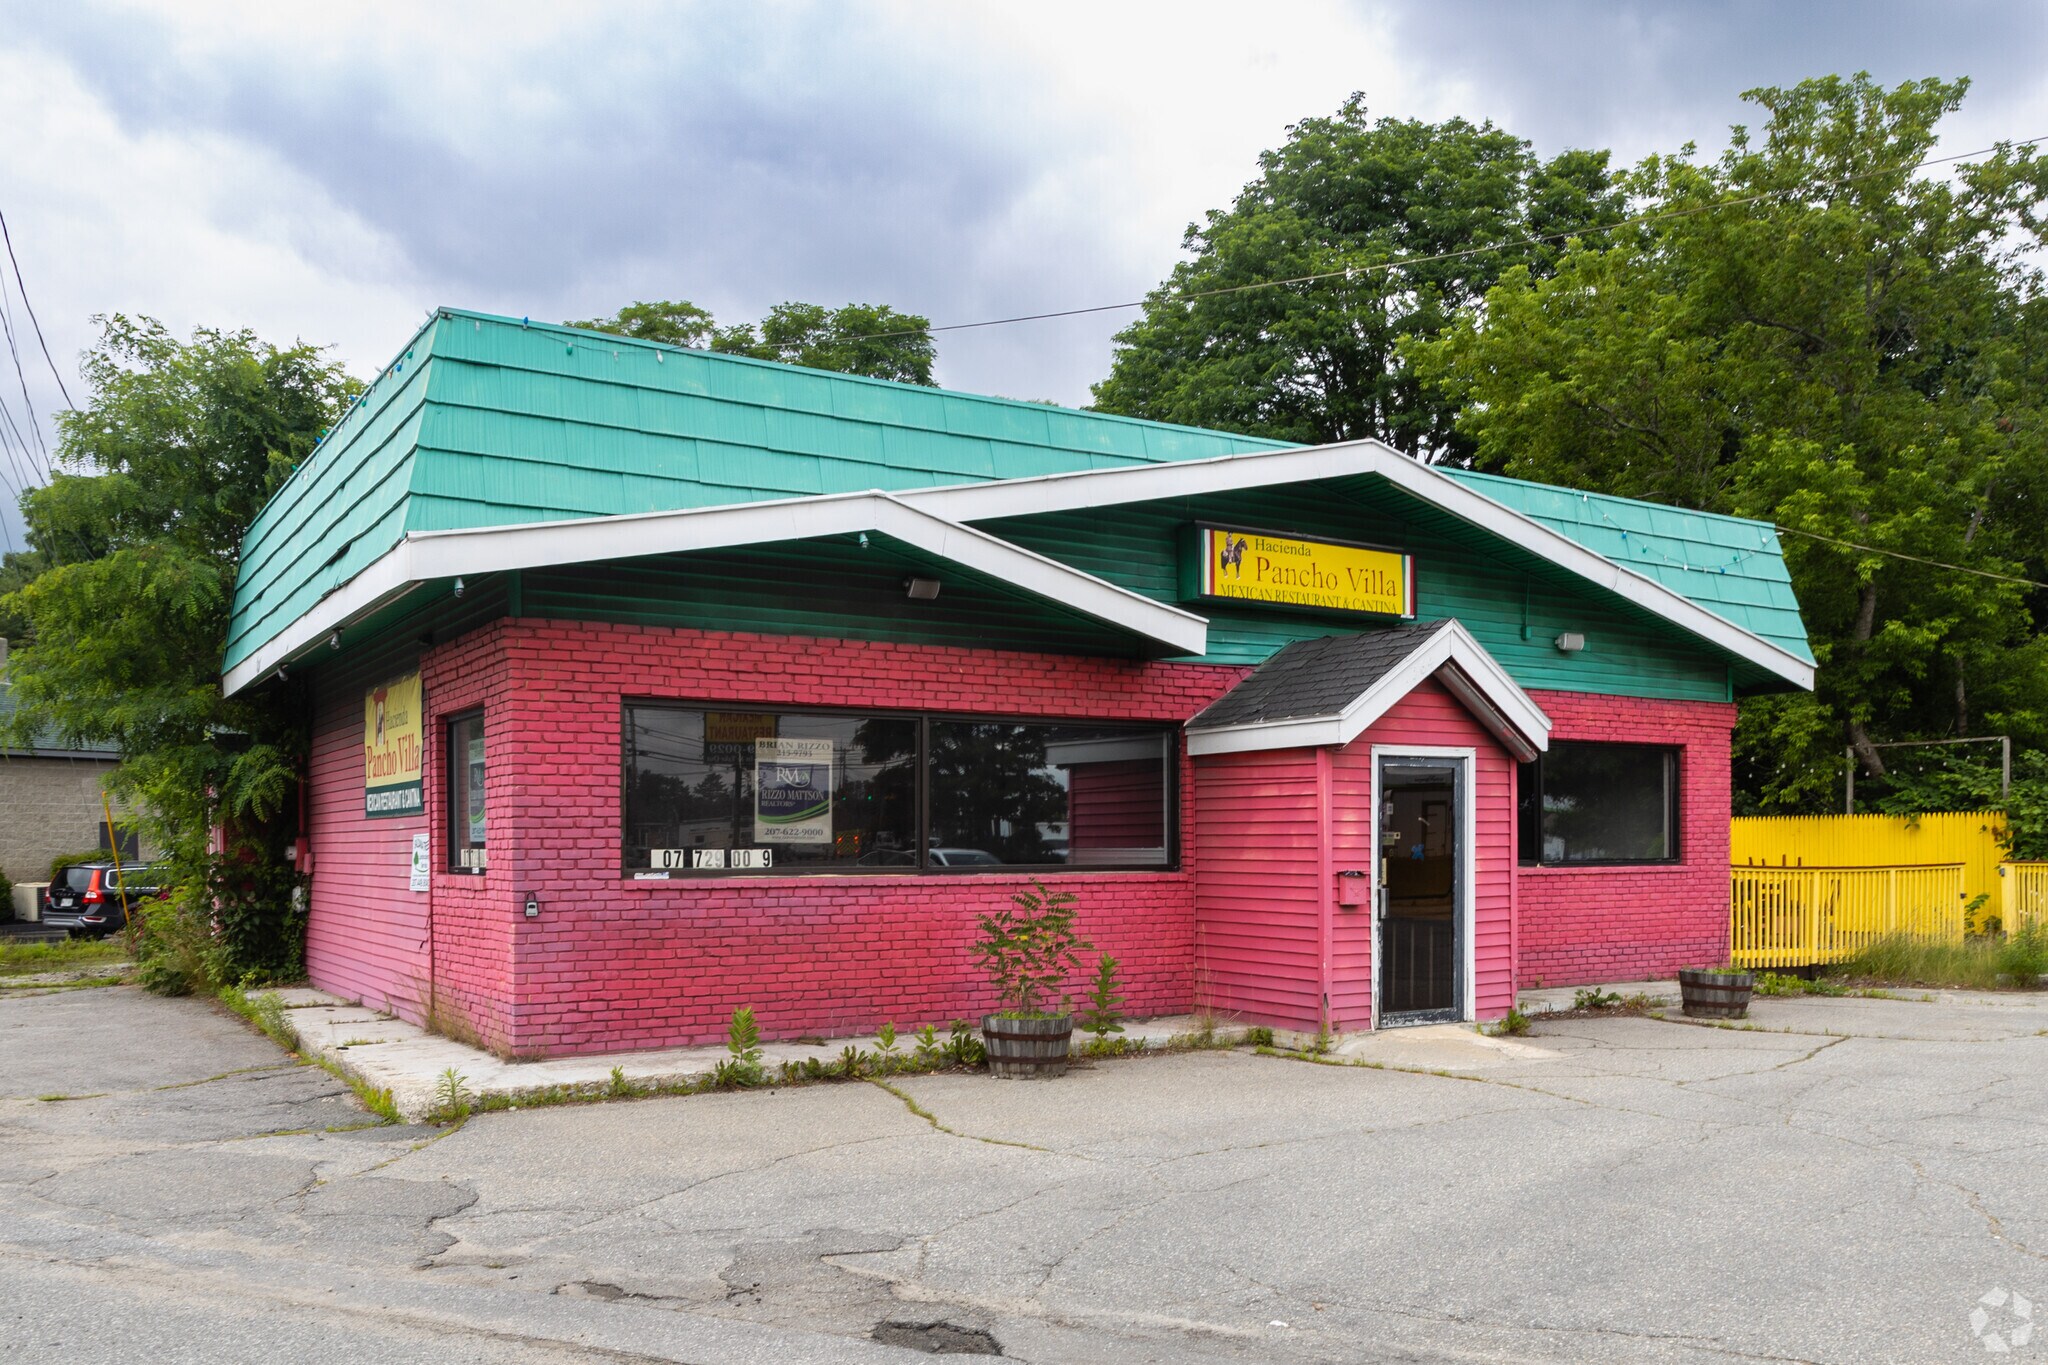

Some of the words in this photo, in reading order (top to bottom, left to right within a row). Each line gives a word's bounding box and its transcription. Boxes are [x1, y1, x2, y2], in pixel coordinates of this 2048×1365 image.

[1255, 538, 1312, 557] Hacienda
[1256, 556, 1338, 591] Pancho
[1345, 566, 1398, 598] Villa
[1220, 583, 1274, 601] MEXICAN
[1275, 589, 1342, 609] RESTAURANT
[1352, 598, 1398, 614] CANTINA
[759, 740, 794, 749] BRIAN
[797, 742, 831, 750] RIZZO
[366, 738, 398, 779] Pancho
[397, 732, 421, 774] Villa
[761, 789, 786, 799] RIZZO
[787, 790, 825, 800] MATTSON
[764, 828, 824, 836] 207-622-9000
[663, 850, 682, 868] 07
